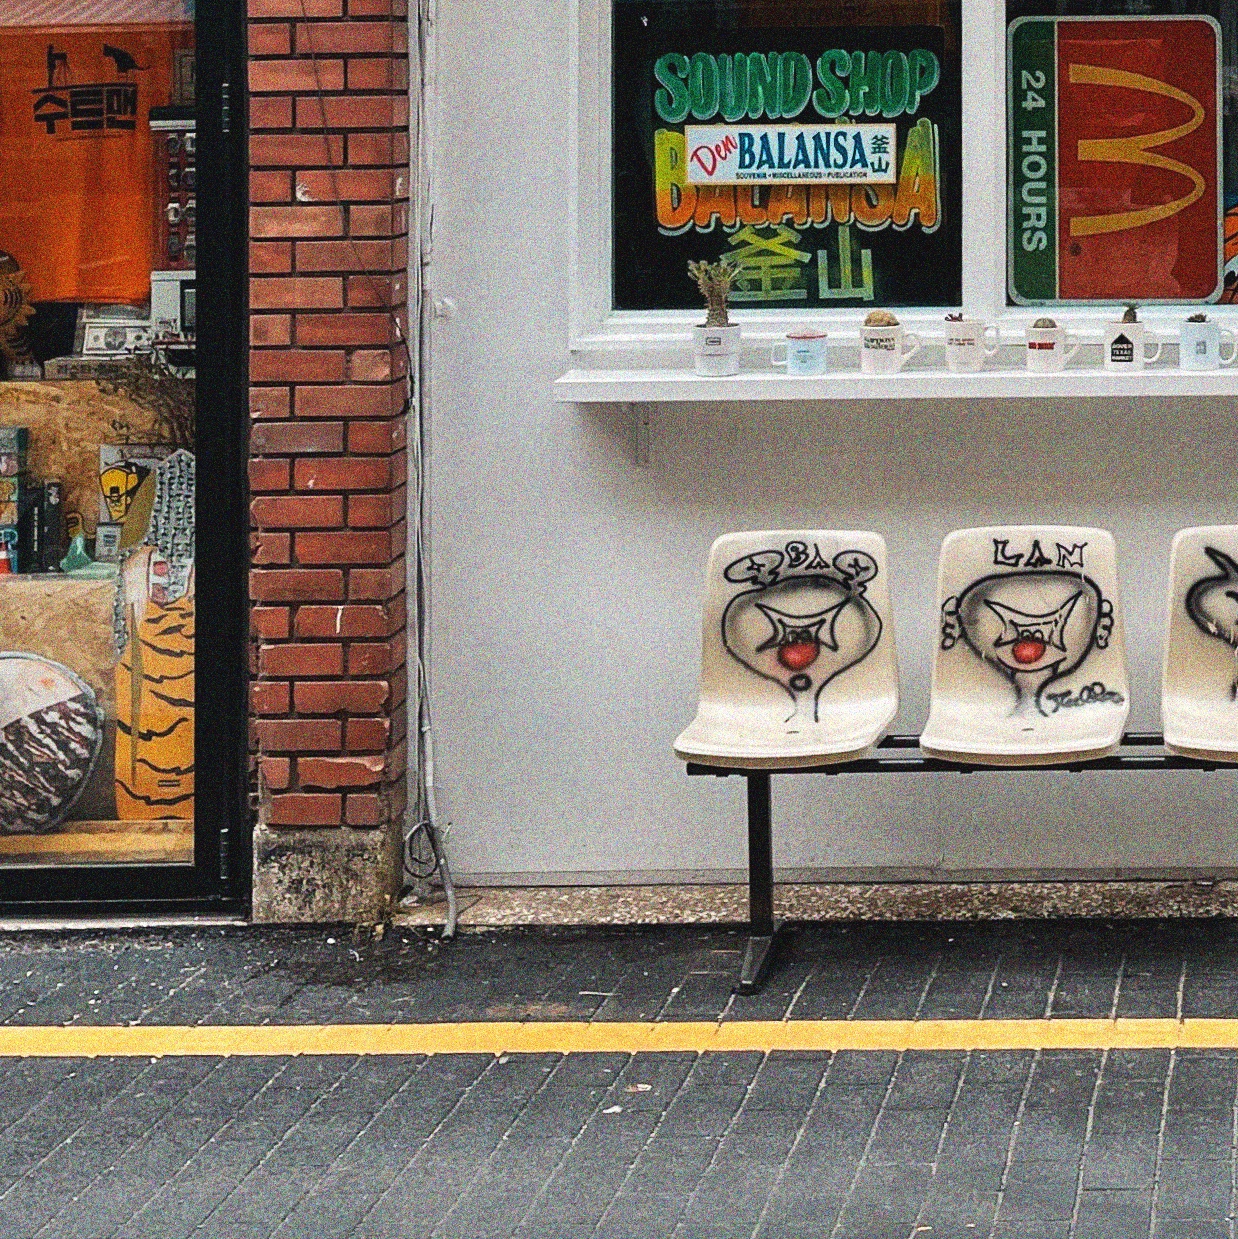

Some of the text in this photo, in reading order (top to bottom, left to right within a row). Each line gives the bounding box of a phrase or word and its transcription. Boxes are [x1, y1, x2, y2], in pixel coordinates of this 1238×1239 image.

[654, 49, 940, 123] SOUND SHOP
[738, 130, 870, 170] BALANSA
[1021, 70, 1048, 252] 24 HOURS
[785, 541, 830, 569] BA
[992, 539, 1088, 568] LAN
